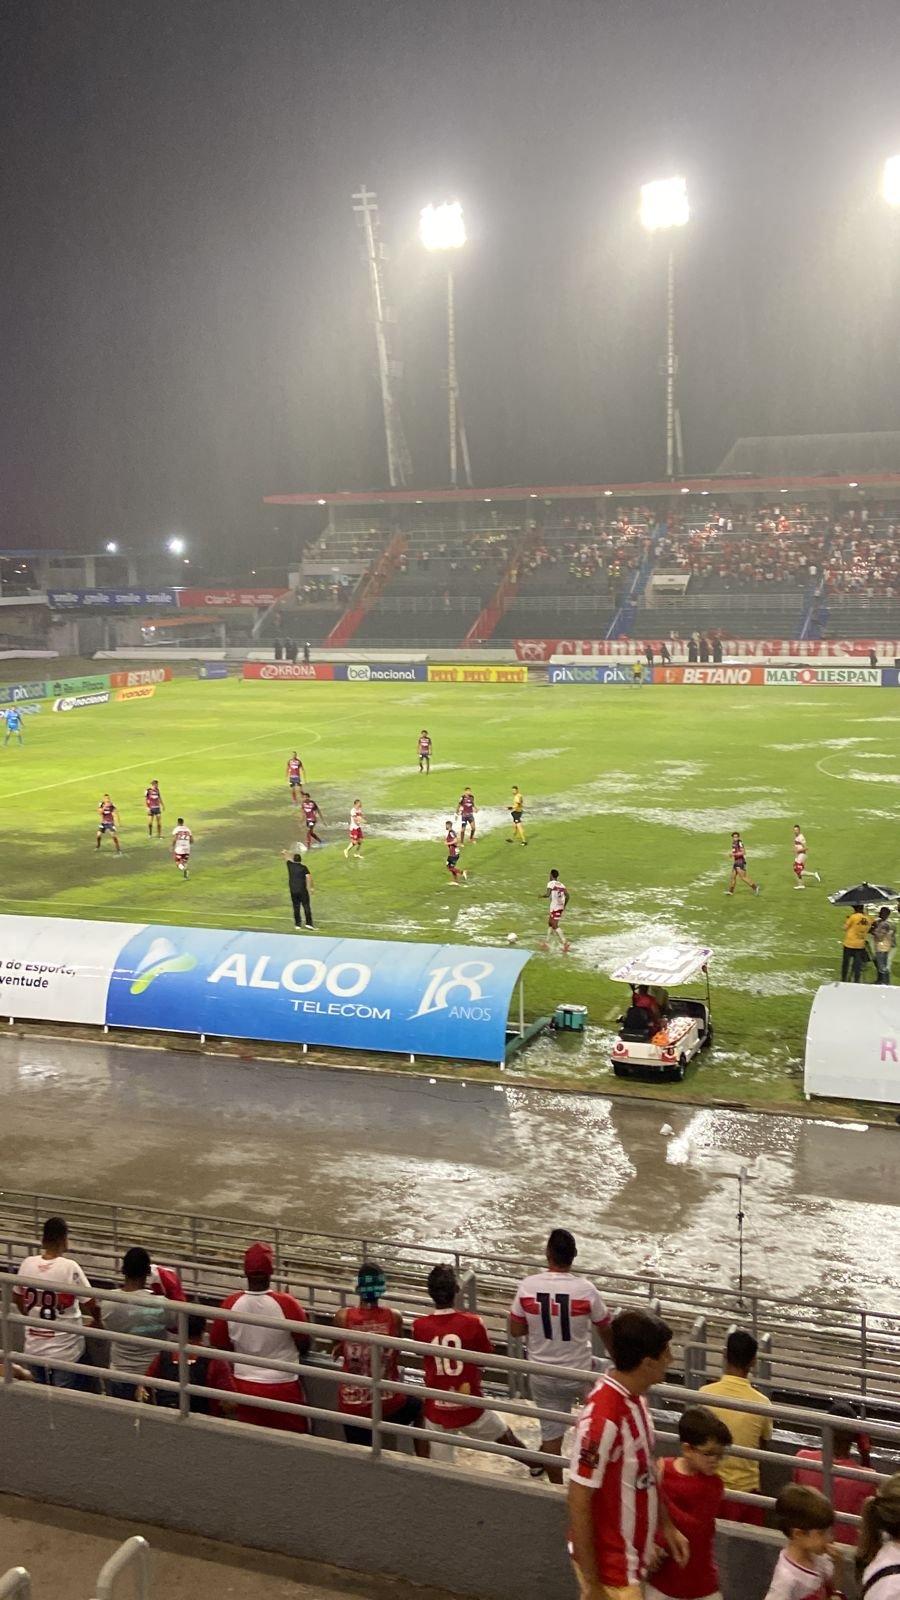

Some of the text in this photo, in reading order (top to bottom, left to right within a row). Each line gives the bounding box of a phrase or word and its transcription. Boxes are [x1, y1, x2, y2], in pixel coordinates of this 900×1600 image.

[127, 668, 164, 686] BETANO
[278, 664, 316, 677] KRONA
[553, 667, 598, 682] pixbet
[682, 668, 751, 684] BETANO
[766, 669, 878, 686] MARQUESPAN
[207, 953, 371, 998] ALOO
[406, 960, 494, 1021] 18
[291, 999, 391, 1020] TELECOM
[449, 1006, 491, 1021] ANOS
[24, 1288, 56, 1320] 28
[536, 1292, 571, 1341] 11
[430, 1333, 463, 1376] 10
